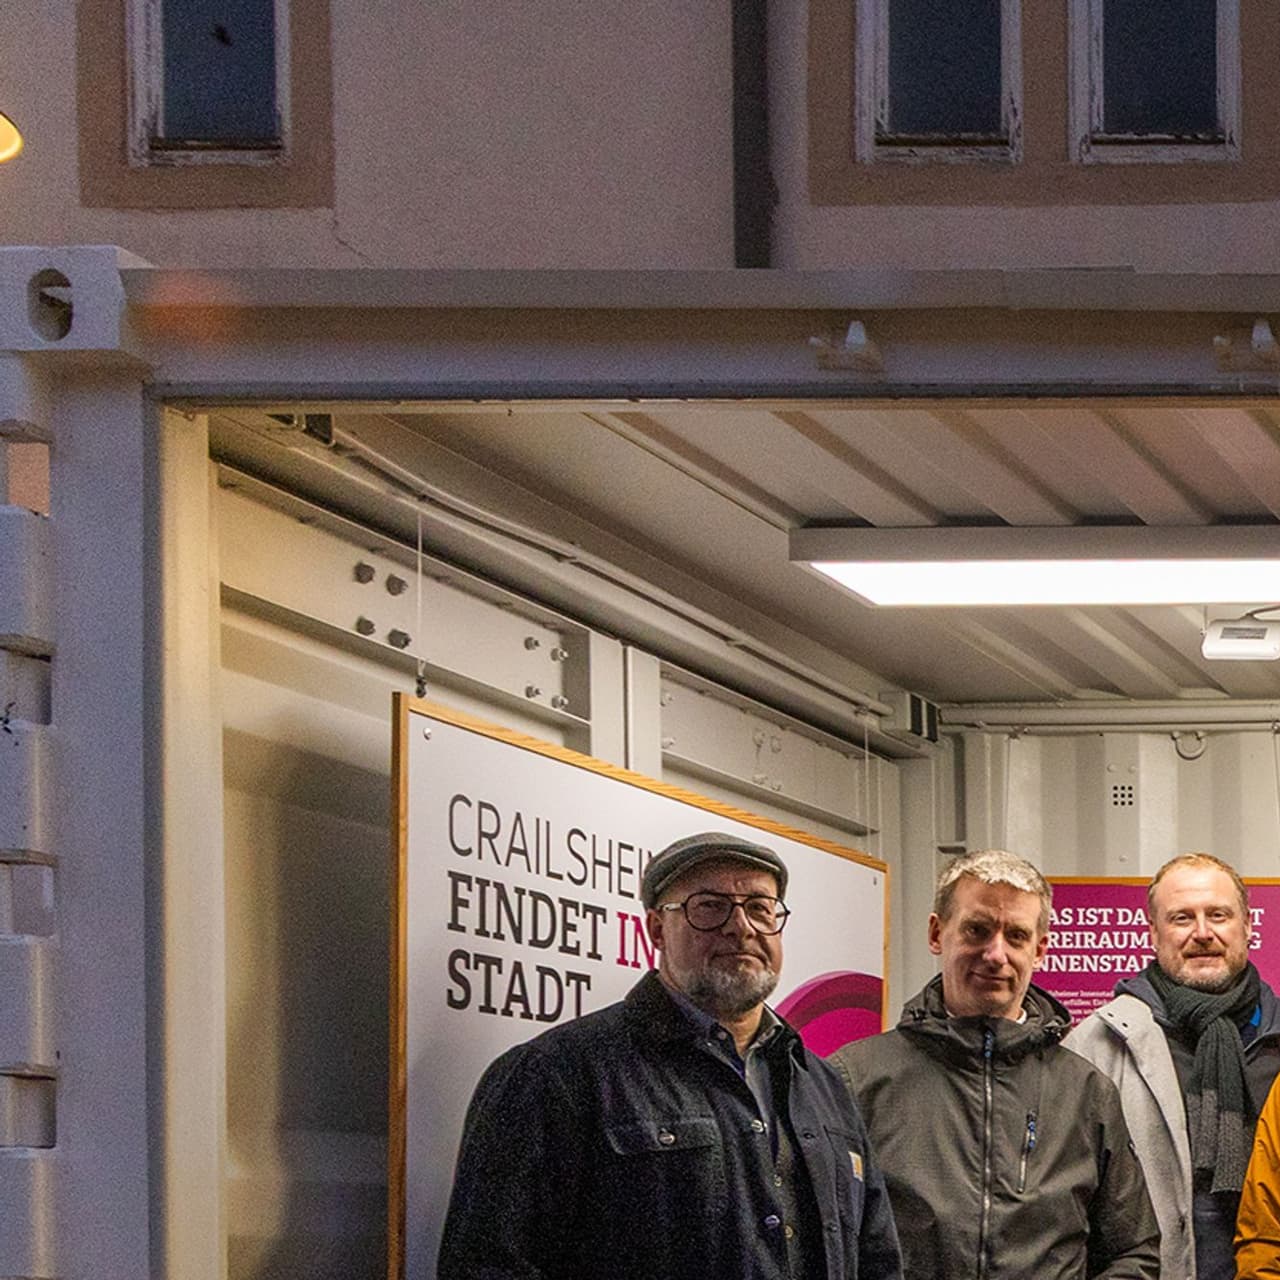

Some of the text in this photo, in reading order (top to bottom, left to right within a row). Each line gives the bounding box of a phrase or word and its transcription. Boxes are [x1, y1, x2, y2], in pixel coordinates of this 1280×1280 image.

[449, 794, 655, 899] CRAILSHEI
[447, 870, 657, 971] FINDET IN
[1047, 908, 1149, 925] AS IST DA
[447, 949, 591, 1023] STADT
